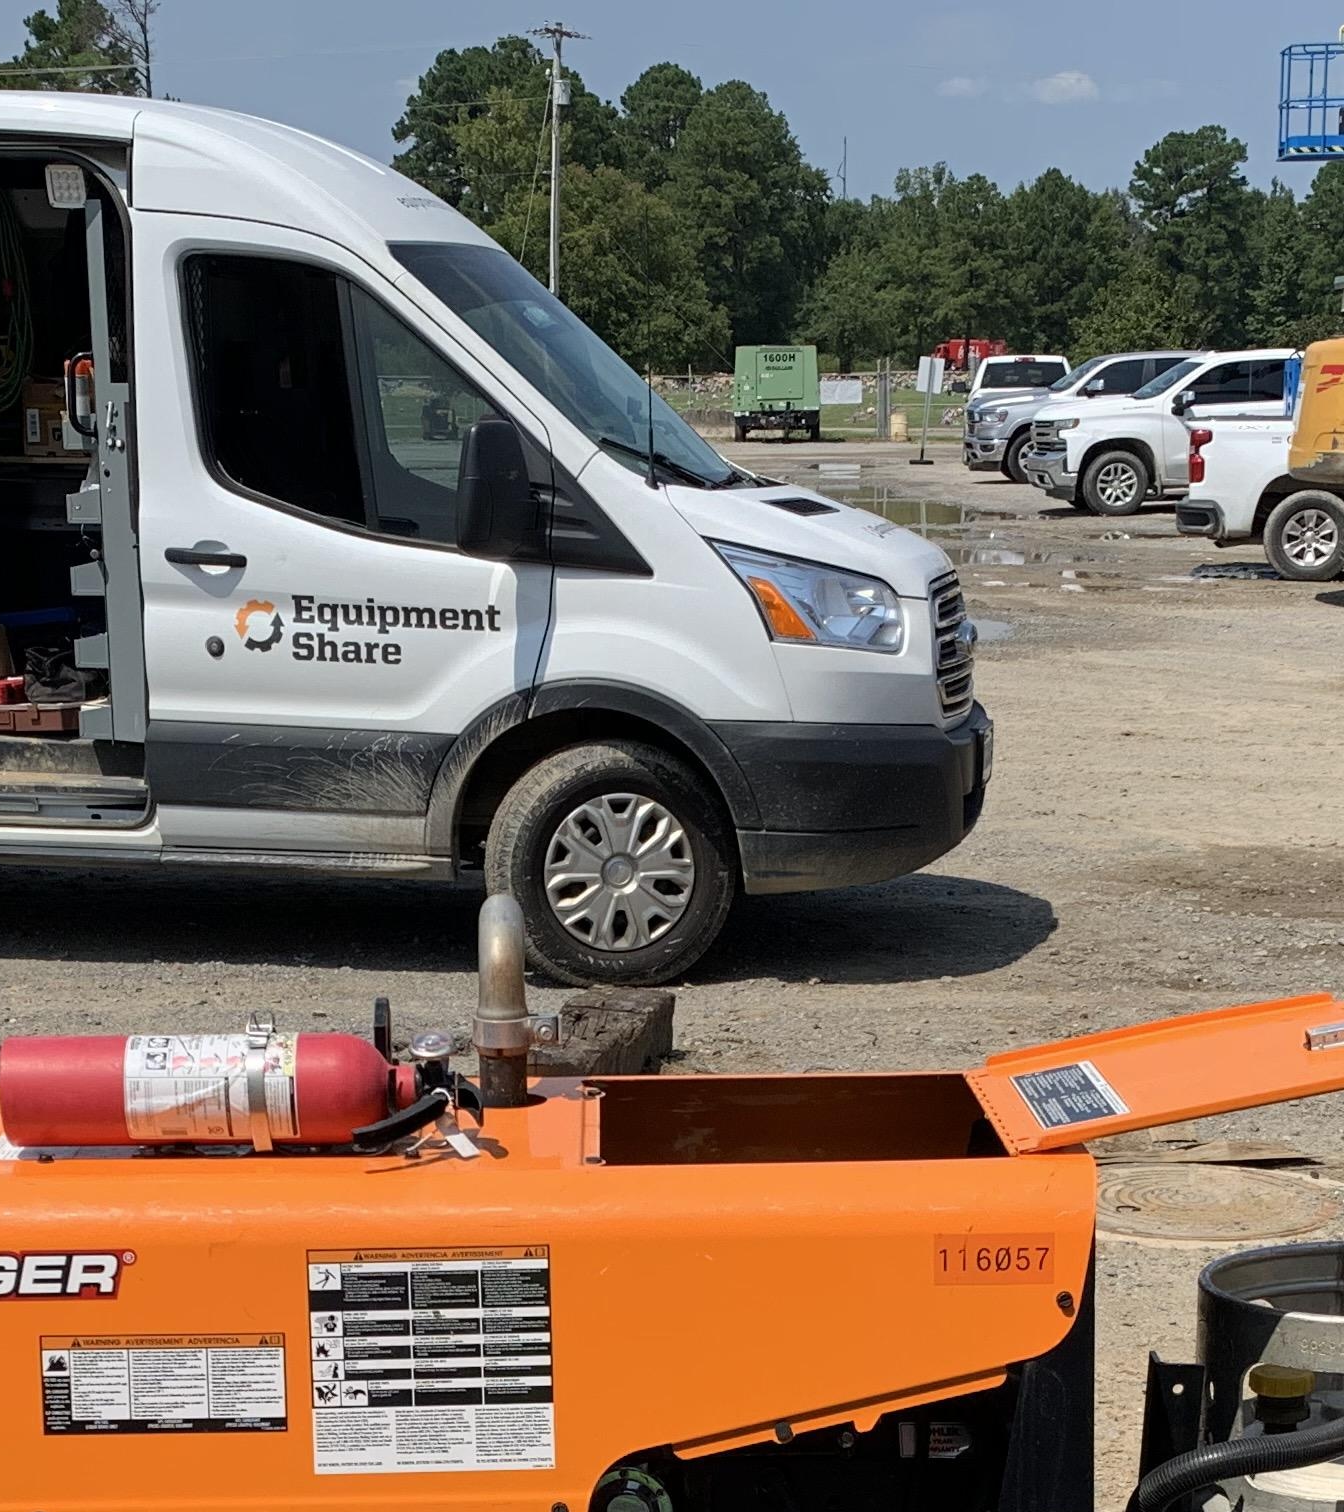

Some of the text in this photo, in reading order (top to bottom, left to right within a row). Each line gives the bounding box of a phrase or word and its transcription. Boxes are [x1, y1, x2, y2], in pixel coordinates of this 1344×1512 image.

[763, 353, 796, 362] 1600H
[291, 594, 501, 634] Equipment
[291, 632, 402, 665] Share
